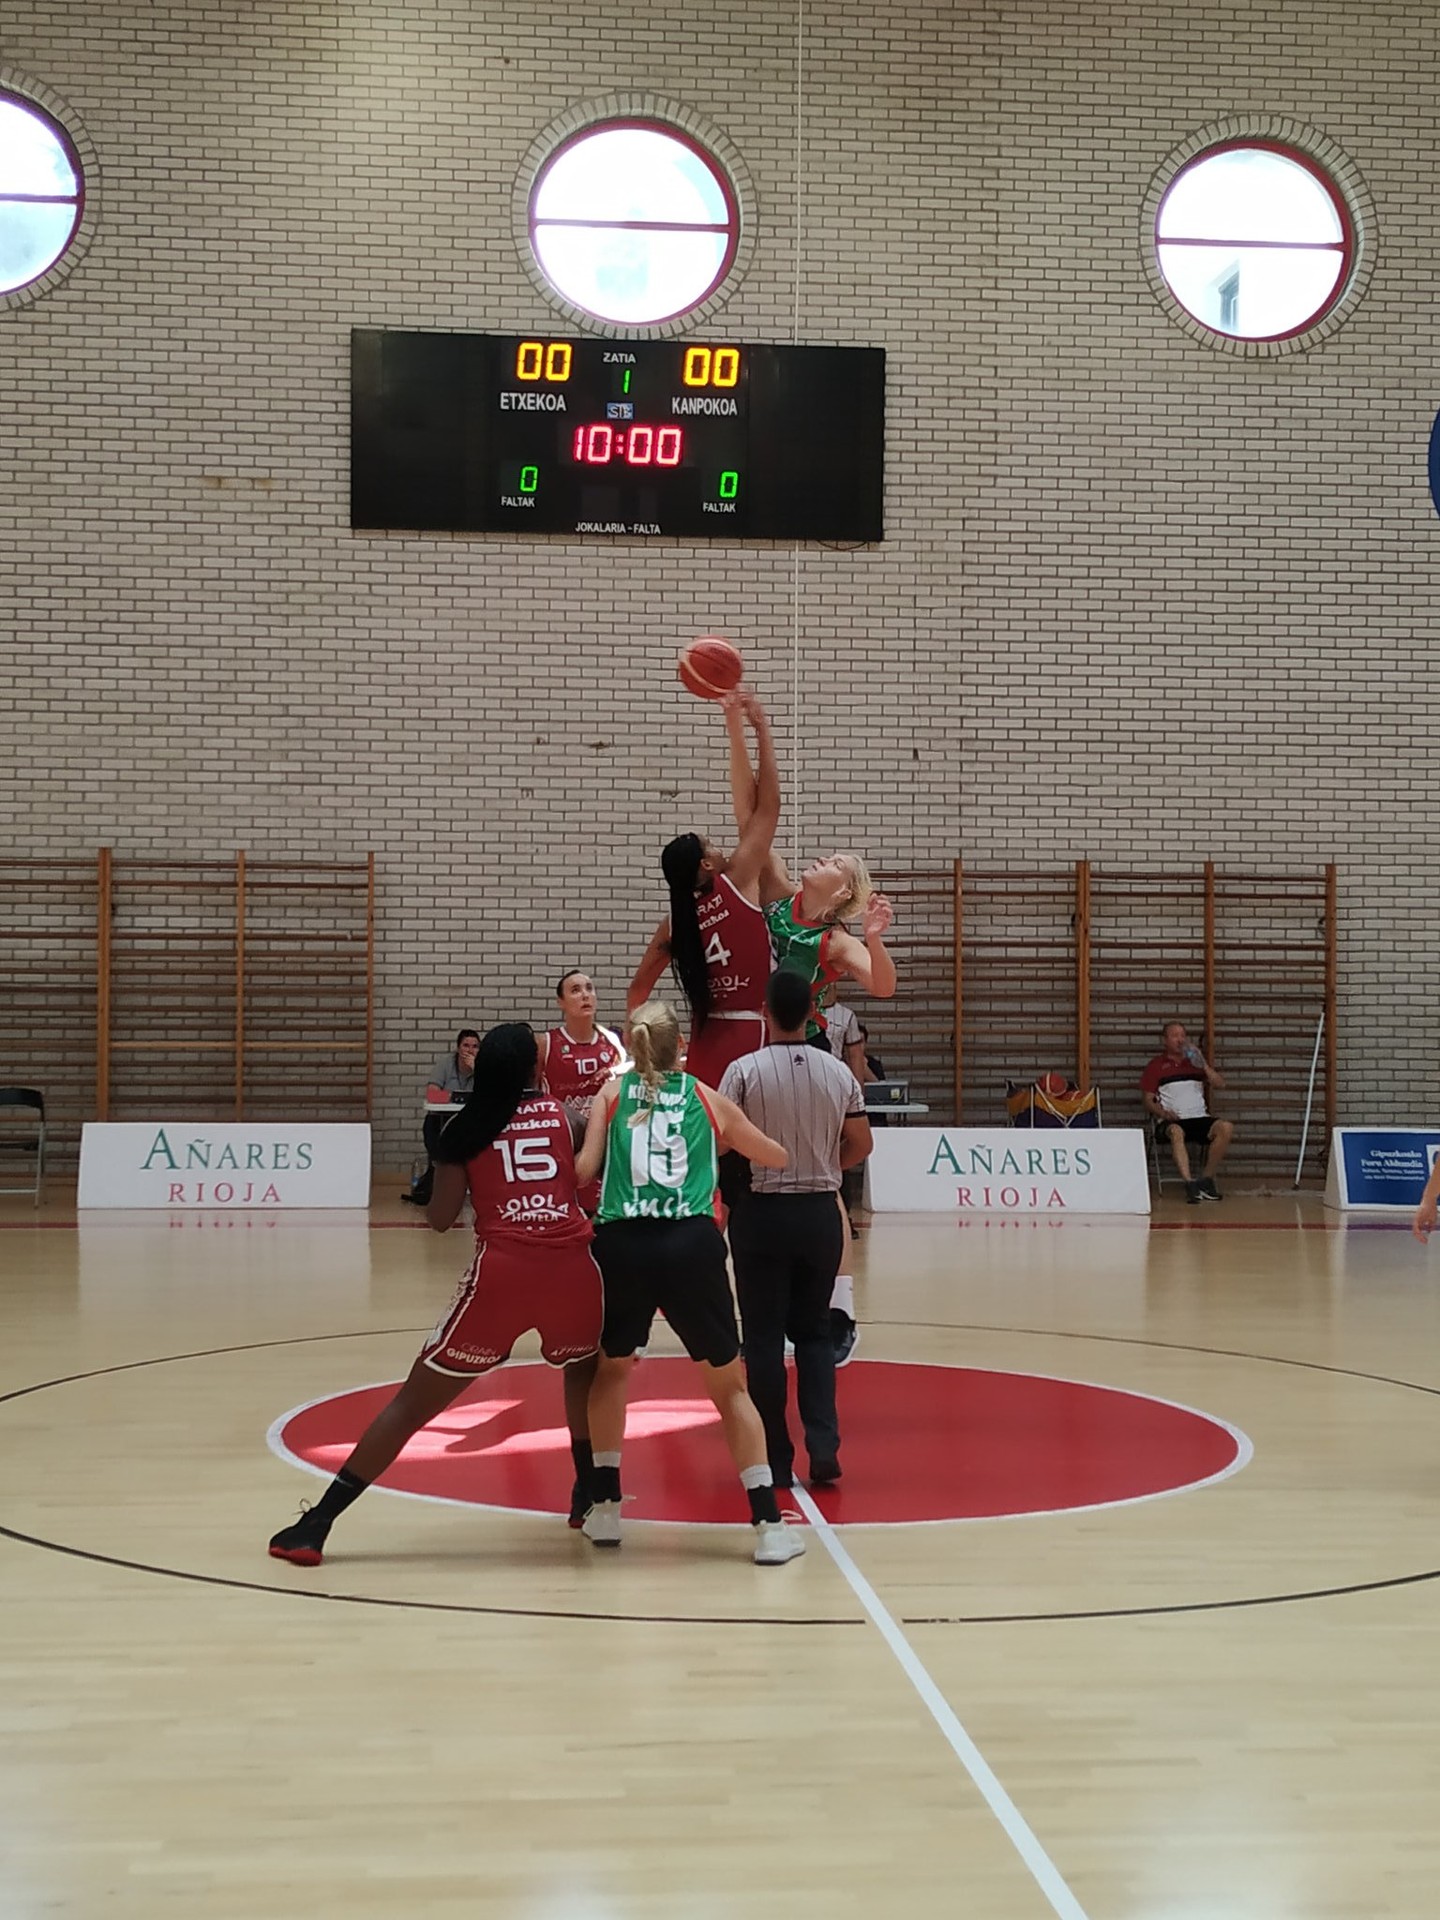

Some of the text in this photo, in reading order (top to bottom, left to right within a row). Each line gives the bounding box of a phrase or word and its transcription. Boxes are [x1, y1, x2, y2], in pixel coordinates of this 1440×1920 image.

[517, 342, 572, 382] 00
[602, 352, 637, 364] ZATIA
[683, 347, 740, 387] 00
[623, 369, 632, 394] 1
[500, 391, 567, 412] ETXEKOA
[671, 396, 738, 416] KANPOKOA
[574, 425, 682, 465] 10:00
[520, 465, 538, 492] 0
[720, 471, 738, 498] 0
[501, 496, 536, 507] FALTAK
[702, 502, 737, 513] FALTAK
[575, 1058, 598, 1075] 10
[139, 1128, 314, 1170] AÑARES
[492, 1137, 558, 1183] 15
[627, 1107, 689, 1188] 15
[926, 1133, 1092, 1176] AÑARES
[168, 1182, 282, 1203] RIOJA
[957, 1186, 1067, 1208] RIOJA
